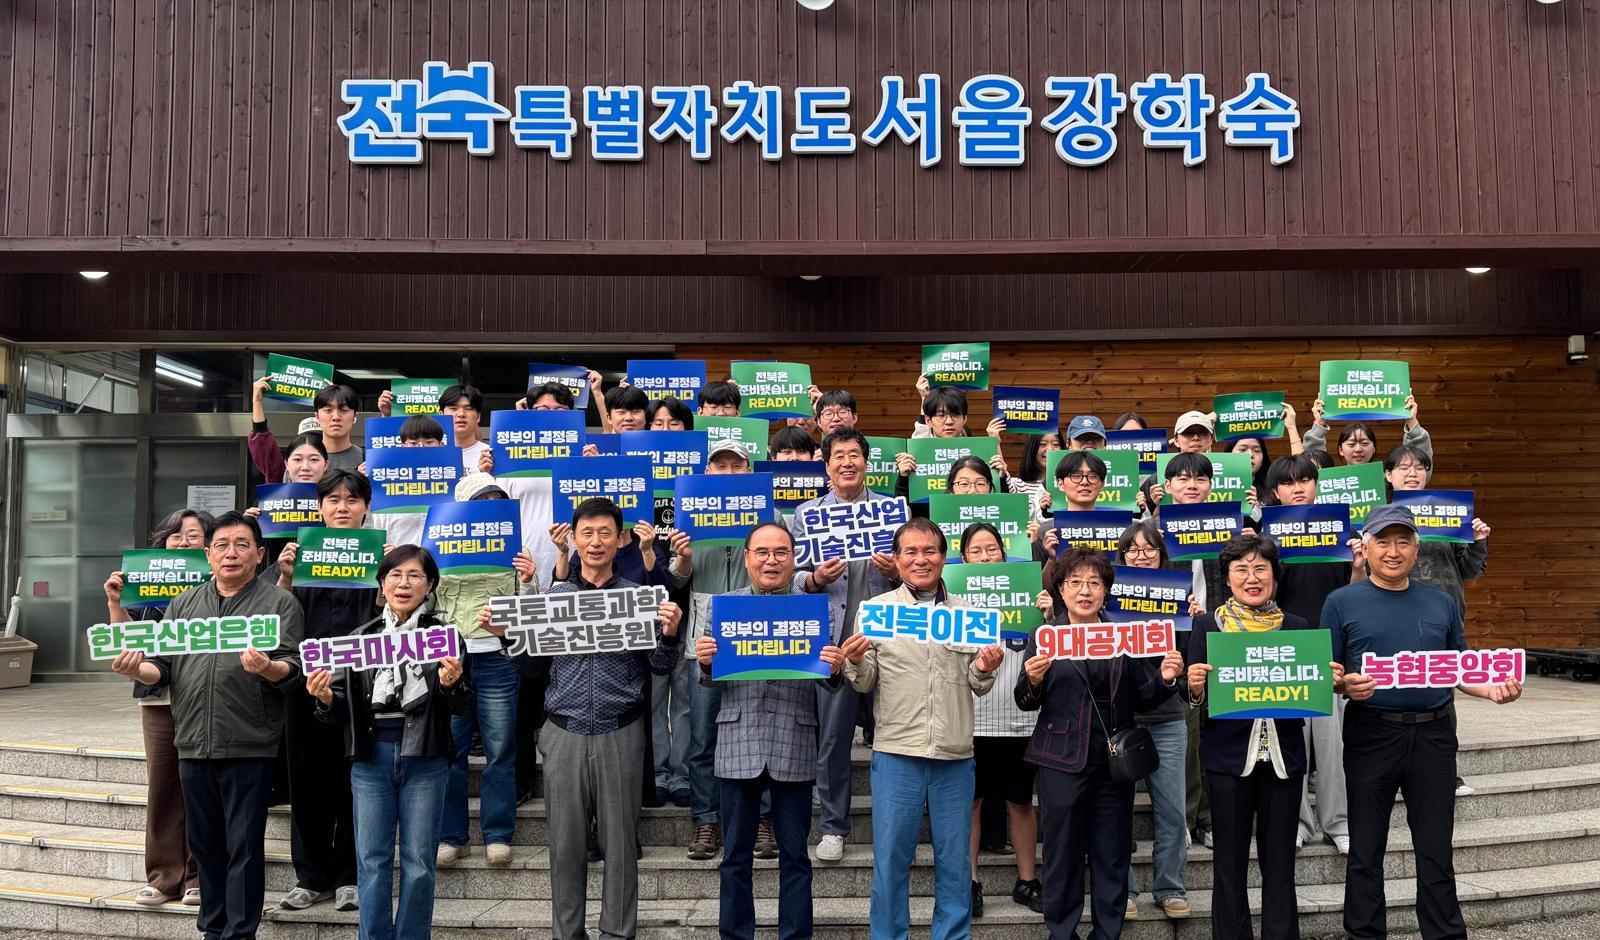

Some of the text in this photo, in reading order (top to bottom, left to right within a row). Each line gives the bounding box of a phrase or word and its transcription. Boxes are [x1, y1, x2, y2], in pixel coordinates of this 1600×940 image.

[861, 73, 1300, 167] 서울장학숙
[941, 351, 969, 361] 전북은
[286, 364, 314, 376] 전북은
[927, 362, 984, 372] 준비됐습니다.
[560, 377, 586, 388] 결정을
[633, 377, 700, 388] 정부의 결정을
[756, 371, 788, 382] 전북은
[935, 373, 976, 382] READY!
[1347, 371, 1384, 382] 전북은
[276, 384, 316, 399] READY!
[411, 385, 439, 395] 전북은
[739, 384, 807, 396] 준비됐습니다.
[1326, 384, 1403, 396] 준비됐습니다.
[396, 394, 441, 404] 준비됐습니
[749, 397, 797, 409] READY!
[997, 400, 1054, 412] 정부의 결정을
[1234, 400, 1264, 411] 전북은
[1338, 398, 1392, 409] READY!
[405, 405, 440, 414] READY
[1003, 410, 1048, 421] 기다립니다
[1219, 410, 1281, 423] 준비됐습니다.
[1229, 420, 1271, 433] READY!
[497, 430, 578, 444] 정부의 결정을
[505, 446, 570, 459] 기다립니다
[664, 451, 701, 464] 결정을
[372, 468, 412, 482] 정부의
[417, 466, 456, 480] 결정을
[652, 466, 694, 479] 립니다
[381, 481, 449, 496] 기다립니다
[559, 478, 646, 493] 정부의 결정을
[773, 477, 824, 488] 부의 결정을
[1319, 476, 1359, 493] 전북은
[568, 494, 638, 509] 기니다
[773, 489, 818, 500] 다립니다
[1314, 489, 1381, 504] 비됐습니다.
[263, 499, 319, 511] 정부의 결정
[681, 495, 767, 511] 정부의 결정을
[1406, 504, 1468, 516] 부의 결정을
[269, 511, 323, 523] 기다립니다
[689, 512, 759, 527] 기다립니다
[804, 498, 908, 535] 한국산업
[960, 505, 1000, 520] 전북은
[428, 521, 514, 540] 정부의 결정을
[1166, 518, 1237, 533] 정부의 결정을
[1269, 520, 1344, 535] 정부의 결정을
[1060, 528, 1094, 539] 정부의
[1175, 531, 1231, 545] 기다립니다
[322, 537, 360, 550] 전북은
[435, 538, 505, 554] 기다립니다
[795, 529, 895, 565] 기술진흥
[1278, 534, 1337, 548] 기다립니다
[301, 550, 378, 564] 준비됐습니다.
[149, 559, 187, 570] 전북은
[312, 565, 366, 577] READY!
[127, 571, 205, 583] 준비됐습니다.
[966, 575, 1010, 591] 전북은
[1110, 583, 1187, 601] 정부의 결정을
[957, 592, 1035, 608] 됐습니다.
[1117, 598, 1178, 614] 기다립니다
[491, 588, 666, 627] 국토교통과학
[720, 620, 820, 637] 정부의 결정을
[861, 603, 998, 645] 전북이전
[90, 617, 279, 658] 한국산업은행
[507, 620, 654, 655] 기술진흥원
[1038, 622, 1174, 658] 9대공제회
[302, 628, 457, 673] 한국마사회
[731, 639, 811, 656] 기다립니다
[1246, 645, 1296, 663] 전북은
[1218, 664, 1324, 683] 준비됐습니다.
[1364, 652, 1522, 686] 농협중앙회
[1234, 685, 1310, 702] READY!
